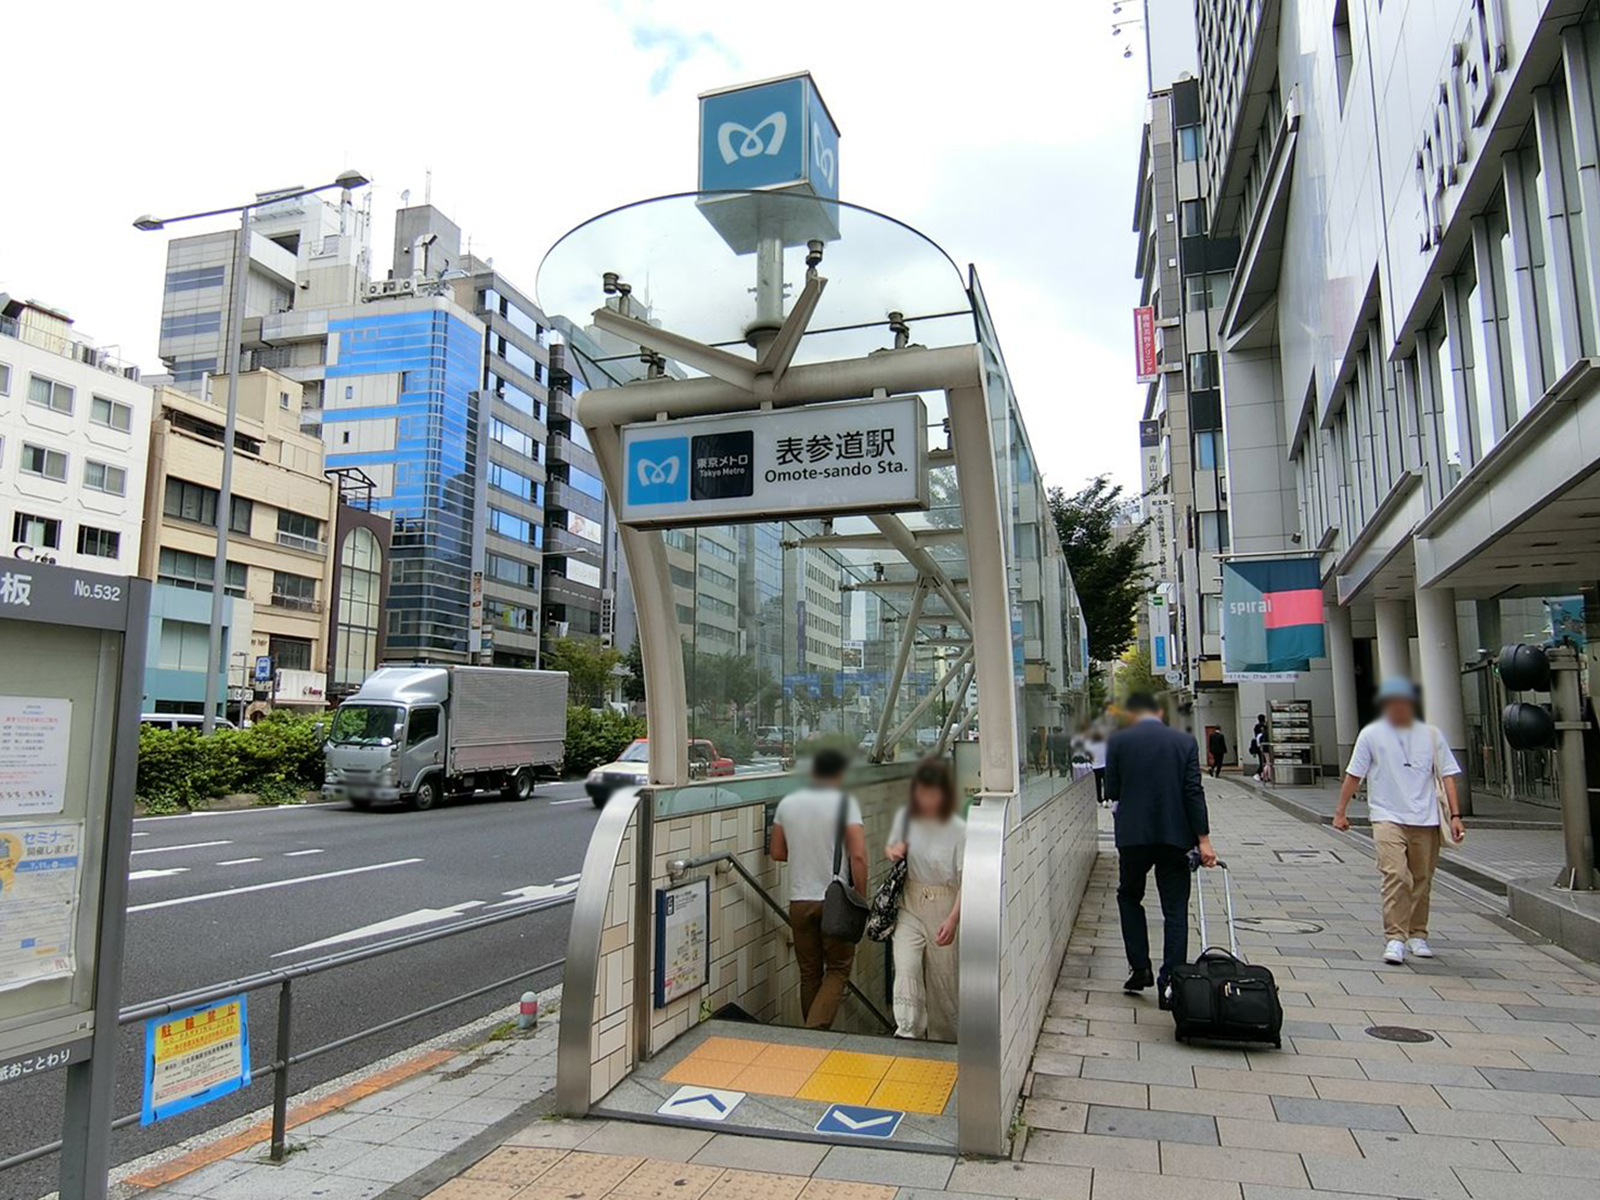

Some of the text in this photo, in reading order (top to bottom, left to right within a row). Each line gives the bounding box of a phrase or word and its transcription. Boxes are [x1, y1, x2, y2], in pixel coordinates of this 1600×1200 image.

[775, 428, 895, 466] 表参道駅
[696, 454, 748, 468] 東京メトロ
[700, 466, 745, 477] Tokyo Metro
[764, 460, 908, 483] Omote-sando Sta.
[0, 572, 32, 606] 板
[74, 579, 121, 602] No.532
[1230, 599, 1272, 615] spiral
[23, 830, 73, 845] セミナー
